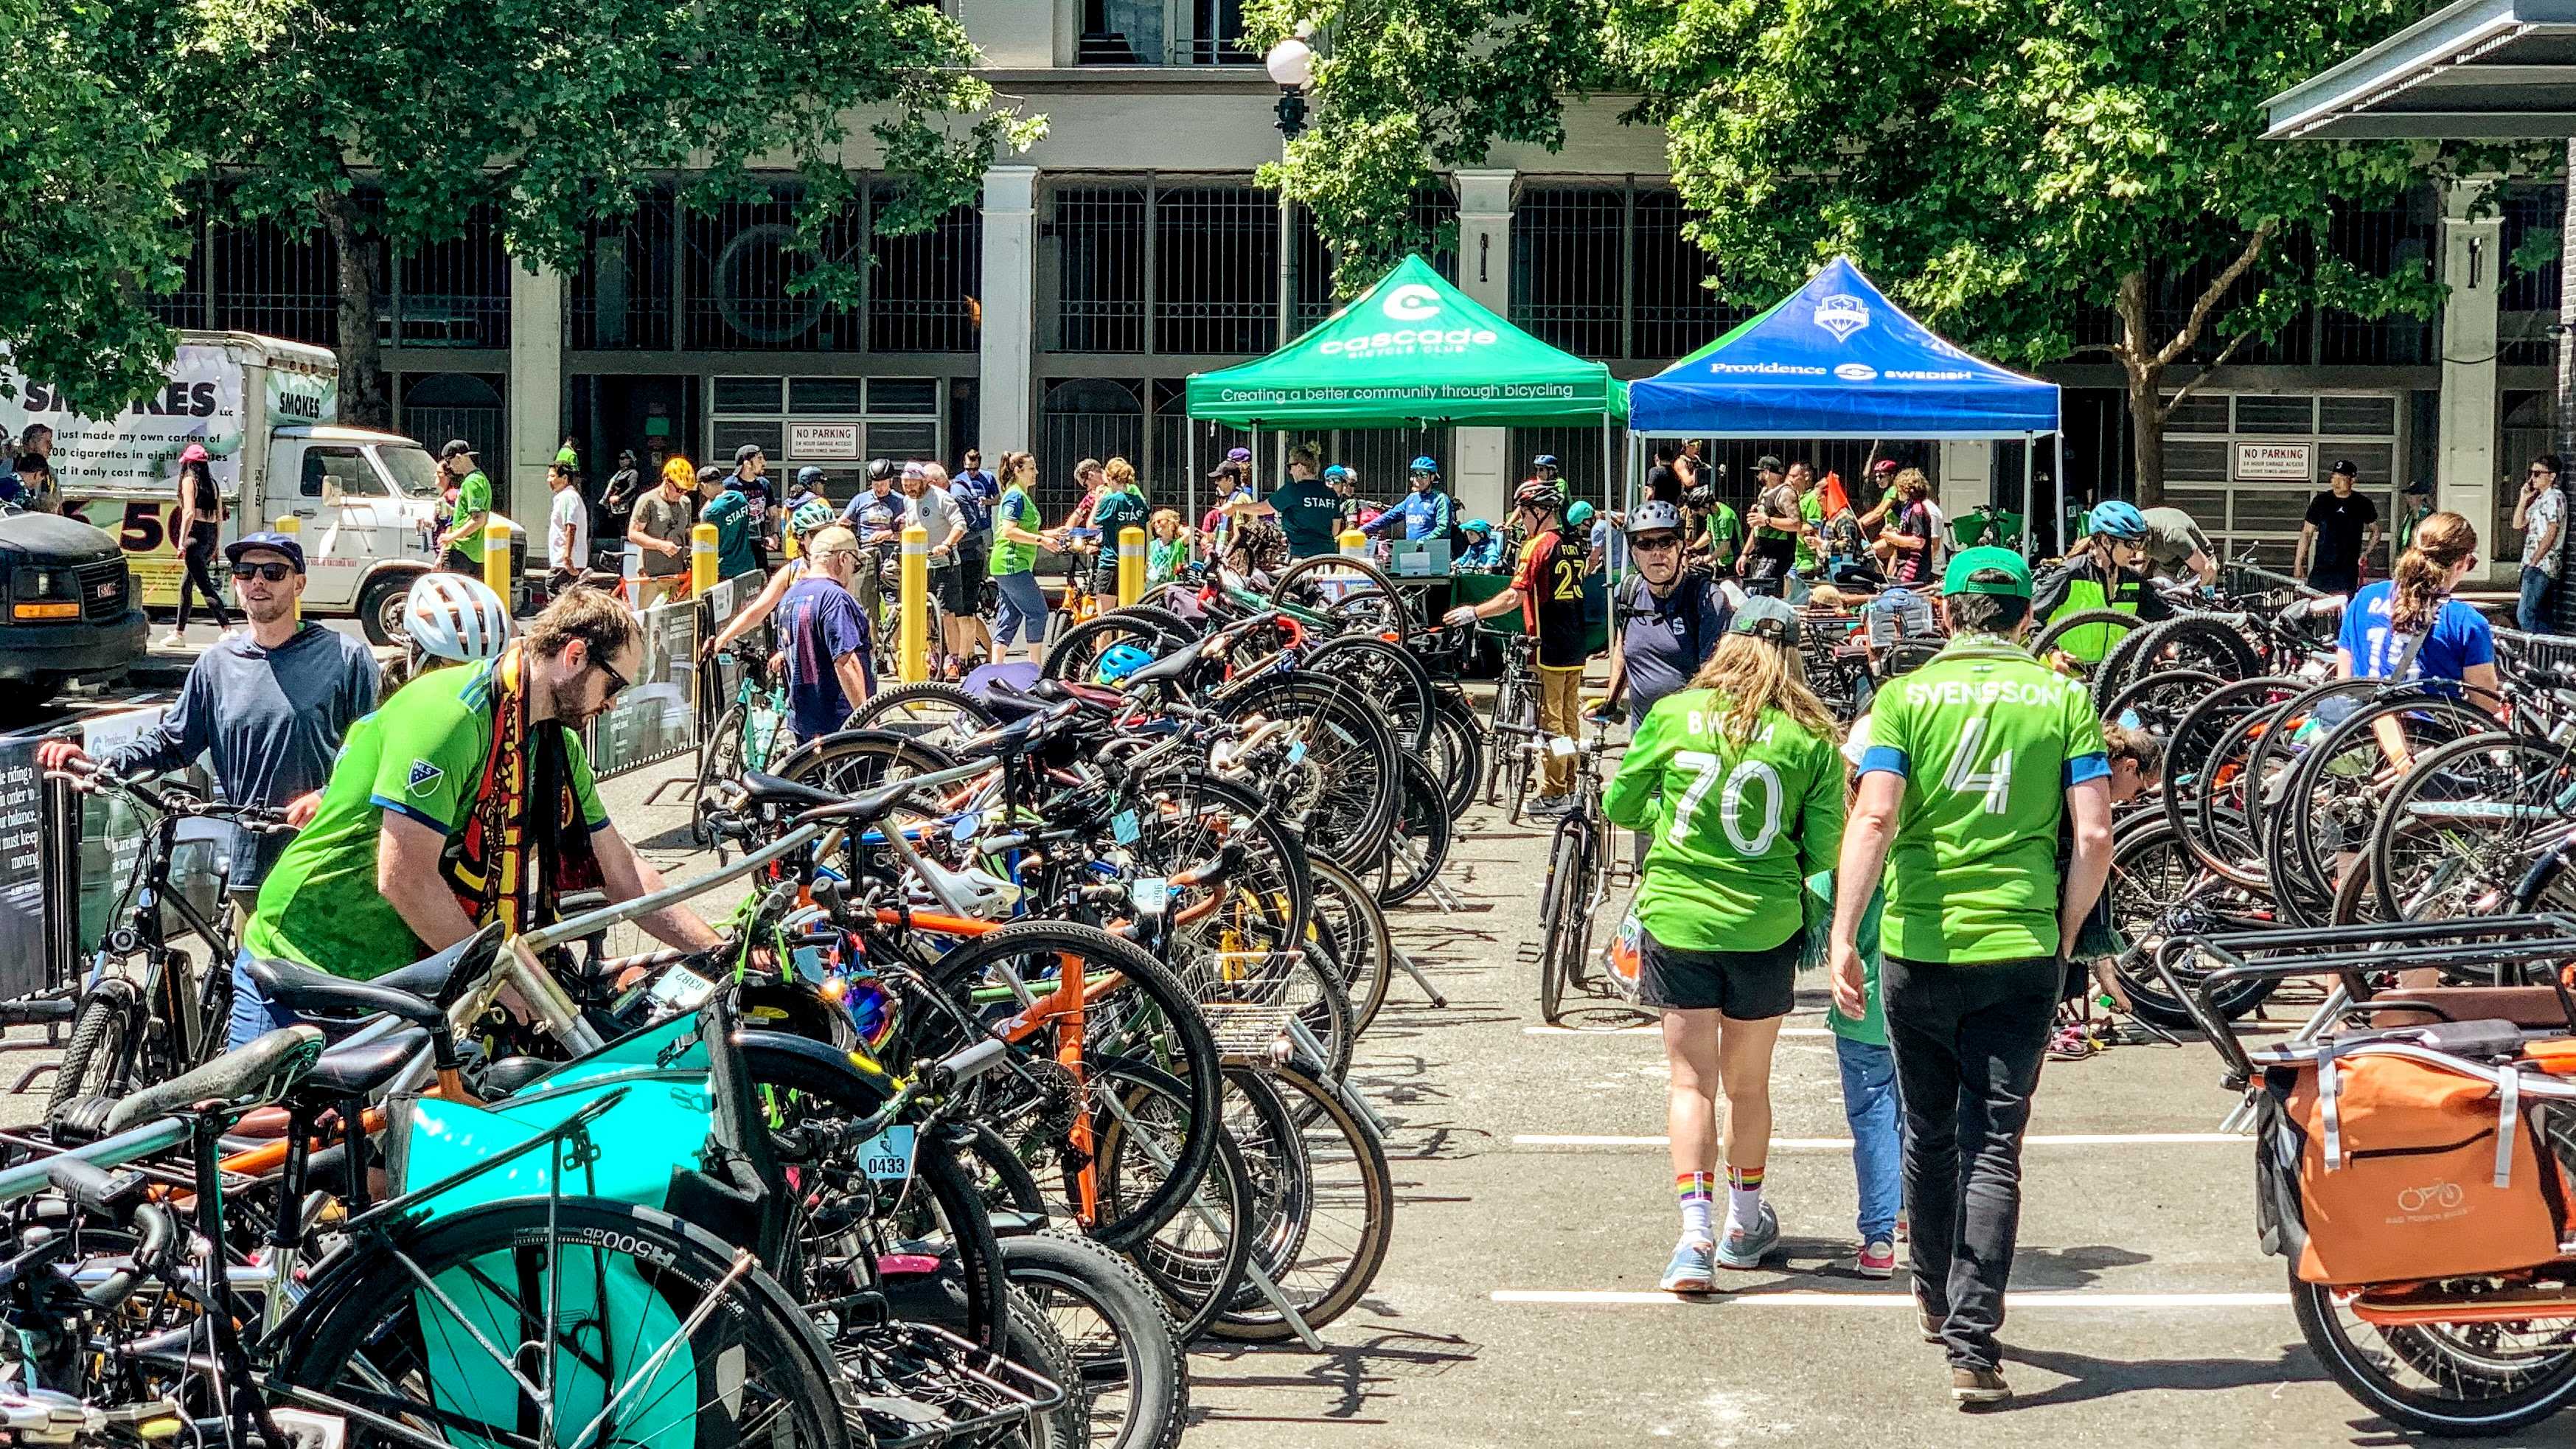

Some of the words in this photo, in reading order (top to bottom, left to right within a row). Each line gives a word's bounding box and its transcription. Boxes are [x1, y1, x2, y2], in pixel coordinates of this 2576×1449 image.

[1320, 328, 1497, 354] cascade
[1348, 345, 1416, 359] BICYCLE
[1423, 345, 1465, 354] CLUB
[1710, 362, 1827, 375] Providence
[1884, 370, 1971, 379] SWEDISH
[1221, 389, 1286, 404] Creating
[1290, 390, 1301, 400] a
[1305, 387, 1350, 400] better
[1353, 385, 1438, 400] community
[1441, 384, 1500, 400] through
[1504, 383, 1573, 398] bicycling
[279, 392, 320, 419] SMOKES
[58, 429, 78, 441] just
[83, 430, 115, 440] made
[119, 432, 136, 444] my
[140, 434, 164, 442] own
[168, 434, 205, 443] carton
[209, 434, 220, 443] of
[796, 429, 809, 438] NO
[812, 429, 851, 438] PARKING
[70, 448, 128, 462] cigarettes
[133, 450, 143, 459] in
[2245, 449, 2258, 458] NO
[2262, 449, 2303, 458] PARKING
[71, 467, 79, 476] it
[83, 468, 107, 479] only
[111, 468, 133, 478] cost
[138, 470, 156, 478] me
[1303, 497, 1336, 510] STAFF
[1561, 544, 1579, 555] FURY
[1905, 680, 2063, 709] SVENSSON
[414, 762, 432, 775] MLS
[1943, 717, 2013, 815] 4
[8, 765, 29, 785] riding
[28, 768, 33, 779] a
[7, 787, 26, 805] order
[27, 788, 35, 801] to
[1668, 750, 1783, 856] 70
[2, 833, 19, 849] must
[20, 830, 38, 848] keep
[675, 969, 706, 991] 0382
[868, 1158, 905, 1174] 0433
